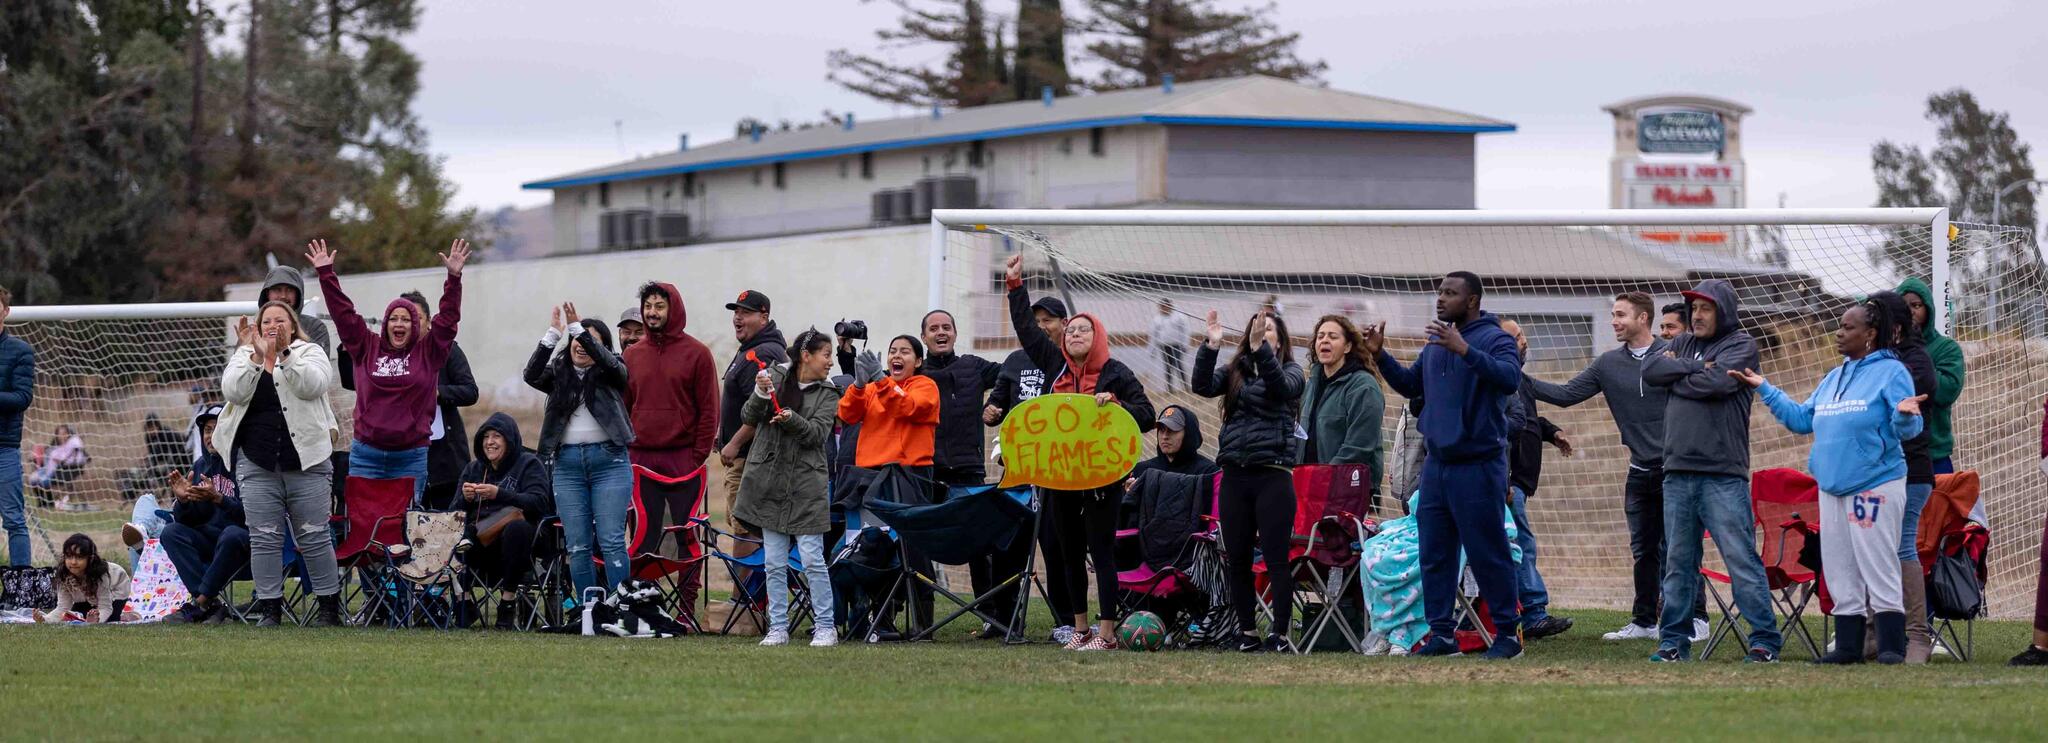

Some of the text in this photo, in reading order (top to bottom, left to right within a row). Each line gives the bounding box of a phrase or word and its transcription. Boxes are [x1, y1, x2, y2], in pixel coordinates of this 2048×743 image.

[1023, 403, 1080, 435] GO
[1016, 435, 1137, 474] FLAMES!
[1853, 495, 1881, 522] 67
